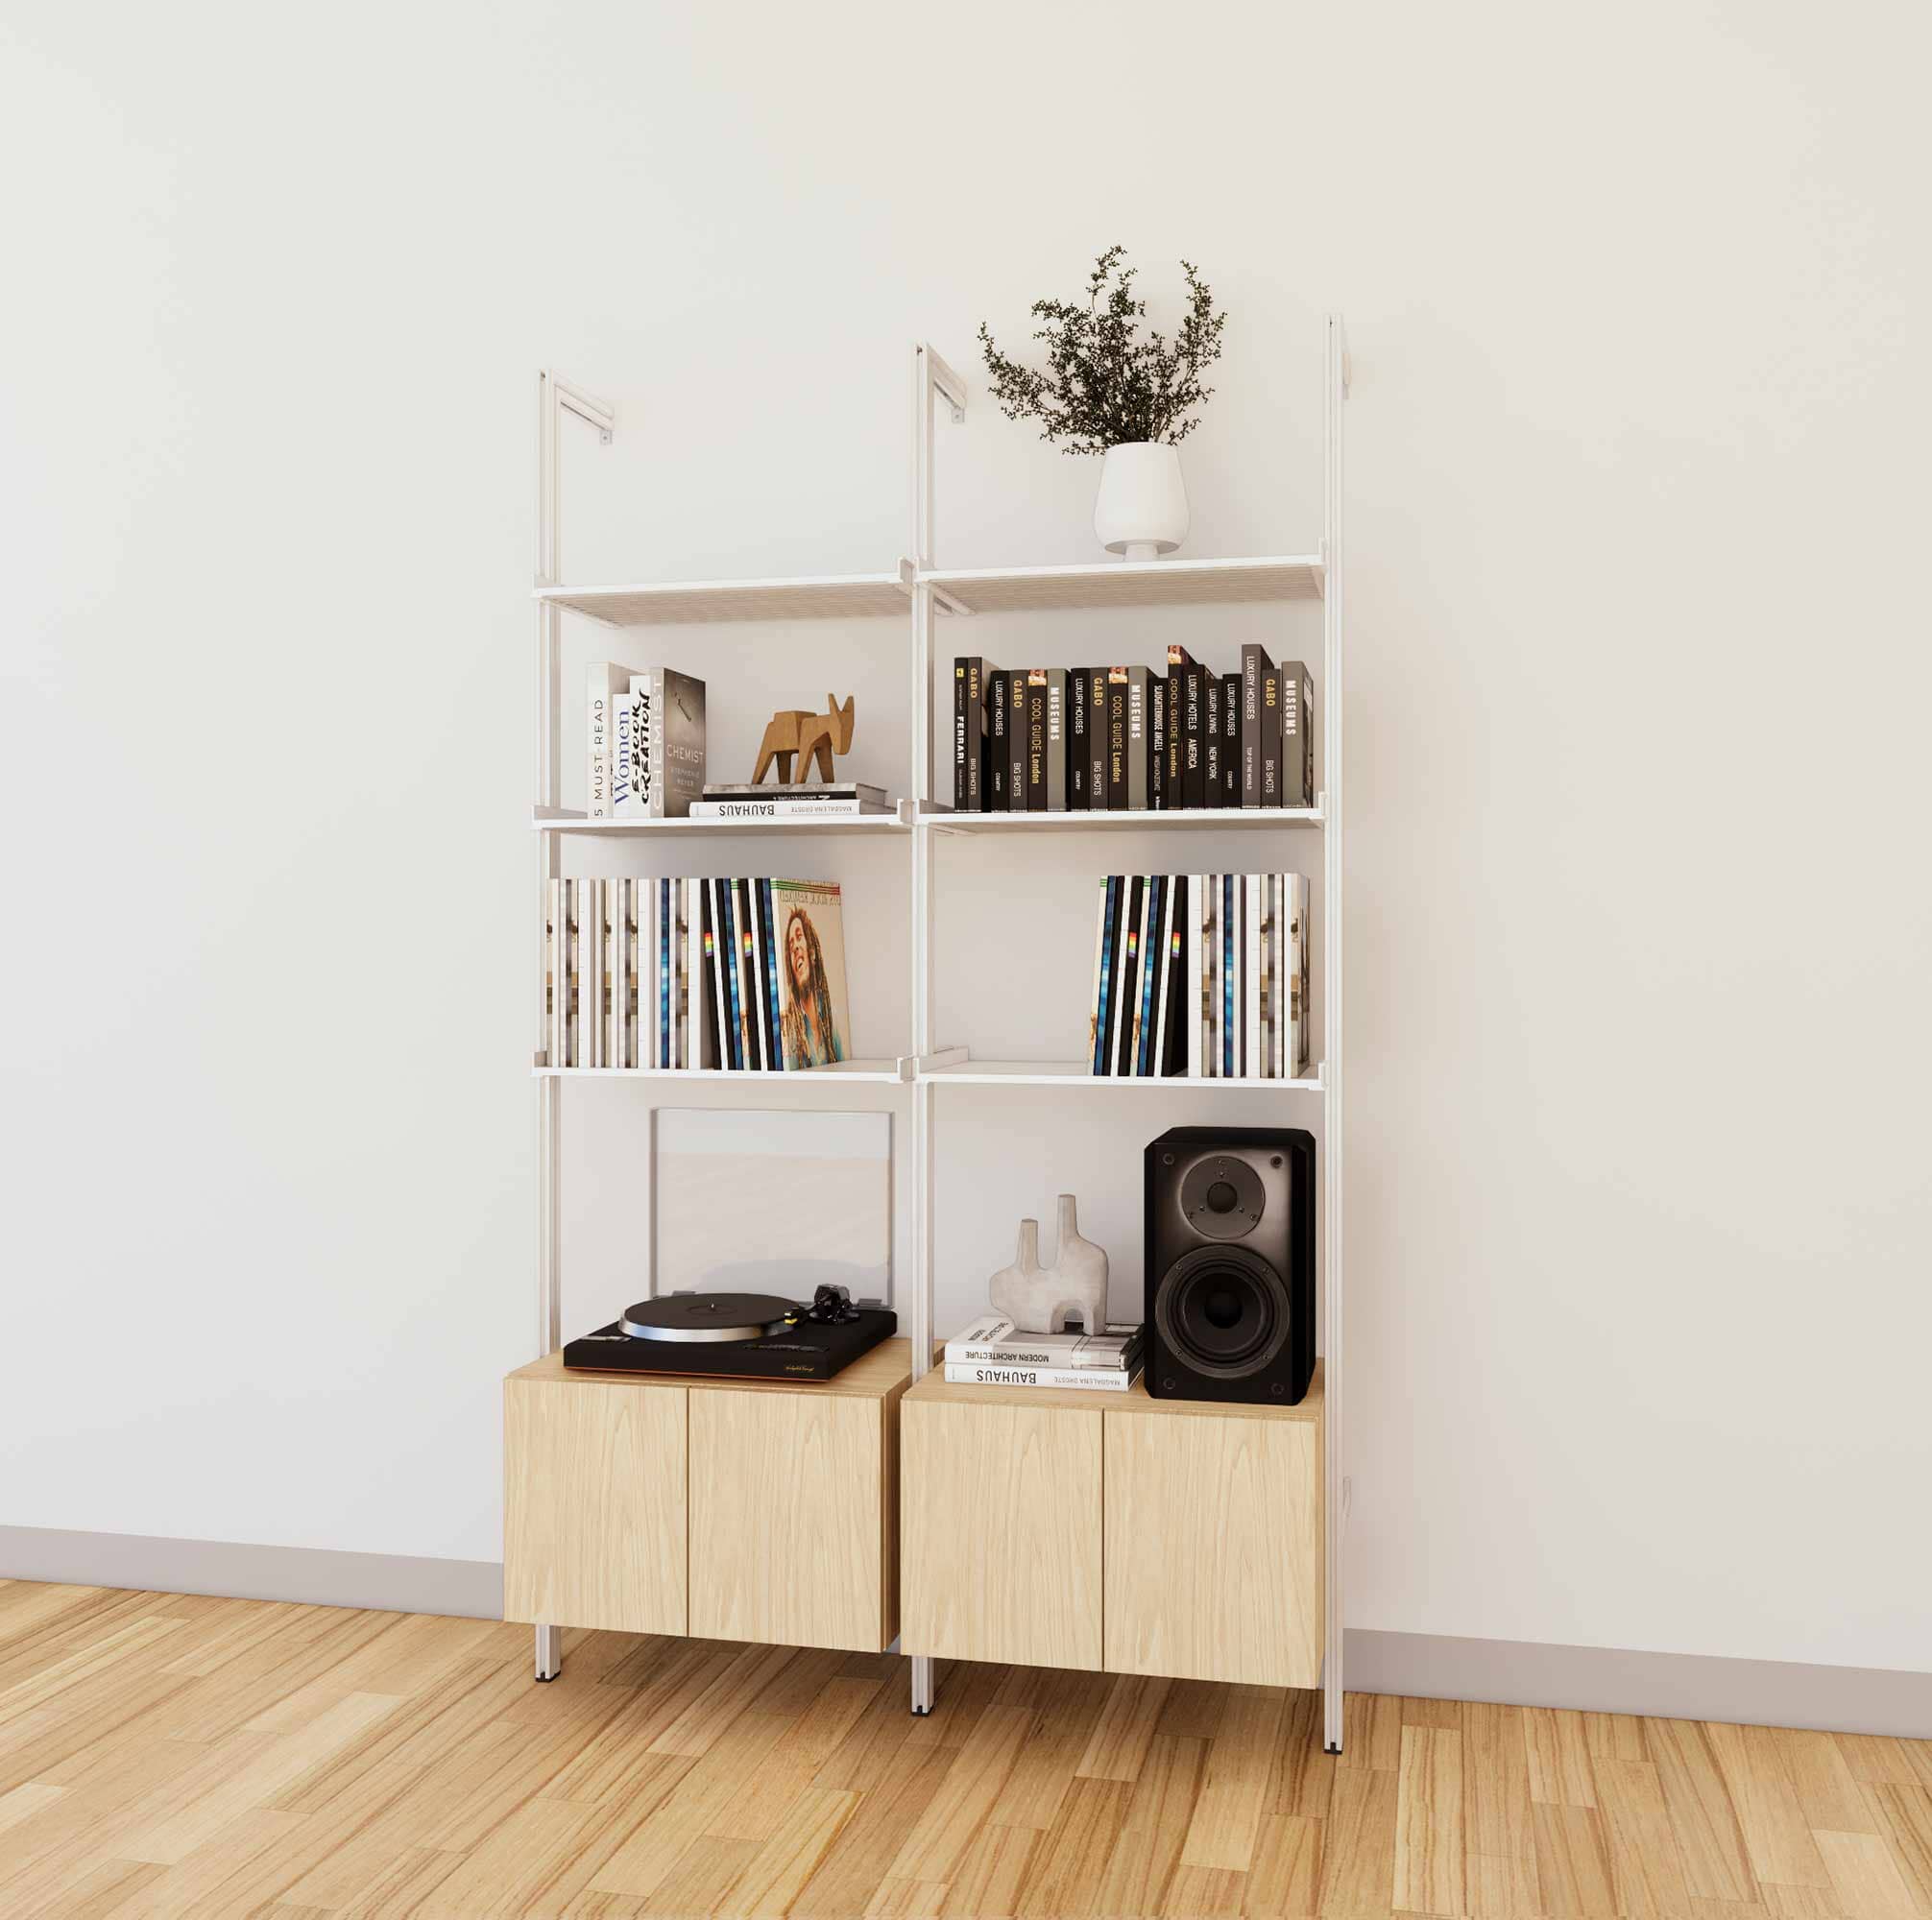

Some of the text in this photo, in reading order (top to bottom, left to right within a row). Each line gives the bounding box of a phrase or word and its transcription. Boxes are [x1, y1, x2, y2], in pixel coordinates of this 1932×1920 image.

[995, 681, 1003, 735] LUXURY HOUSES
[1013, 680, 1023, 708] GABO
[1050, 687, 1059, 740] MUSEUMS
[1075, 678, 1083, 734] LUXURY HOUSES
[1094, 678, 1102, 706] GABO
[1131, 684, 1141, 738] MUSEUMS
[1188, 675, 1196, 730] LUXURY HOTELS
[1246, 656, 1255, 720] LUXURY HOUSES
[1266, 679, 1275, 706] GABO
[1286, 681, 1296, 735] MUSEUMS
[614, 711, 630, 804] Women
[631, 701, 640, 793] E-BOOK
[640, 687, 650, 804] CREATION
[667, 744, 703, 763] CHEMIST
[1031, 698, 1041, 783] COOL GUIDE London
[1112, 696, 1122, 782] COOL GUIDE London
[1188, 739, 1196, 769] AMERICA
[1266, 759, 1274, 793] BIG SHOTS
[719, 804, 774, 816] BAUHAUS
[965, 1351, 1049, 1362] MODERN ARCHITECTURE
[976, 1370, 1036, 1383] BAUHAUS
